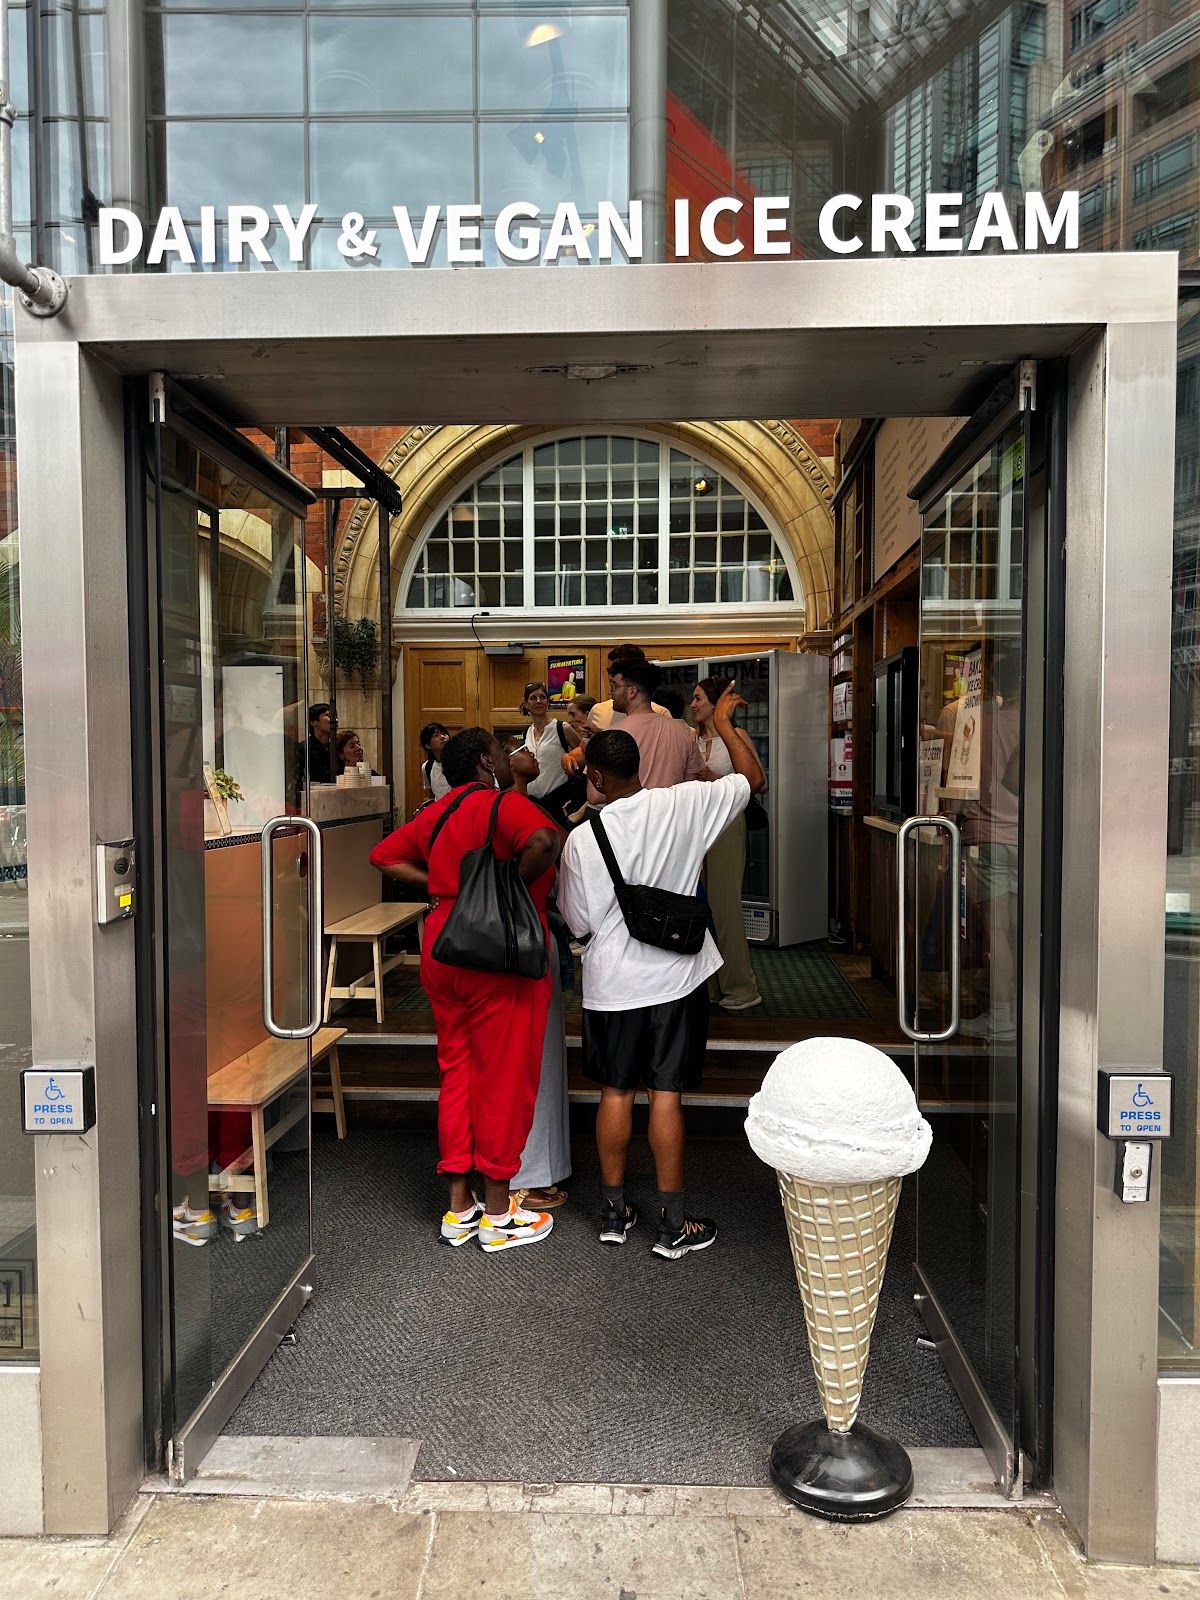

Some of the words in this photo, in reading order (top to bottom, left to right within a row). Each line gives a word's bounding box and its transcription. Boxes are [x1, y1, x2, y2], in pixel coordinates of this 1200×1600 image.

[98, 204, 319, 265] DAIRY
[337, 211, 378, 258] &
[392, 200, 644, 264] VEGAN
[675, 195, 791, 257] ICE
[818, 190, 1080, 255] CREAM
[34, 1104, 73, 1113] PRESS
[1120, 1111, 1161, 1120] PRESS
[1120, 1124, 1132, 1132] TO
[1136, 1124, 1161, 1132] OPEN
